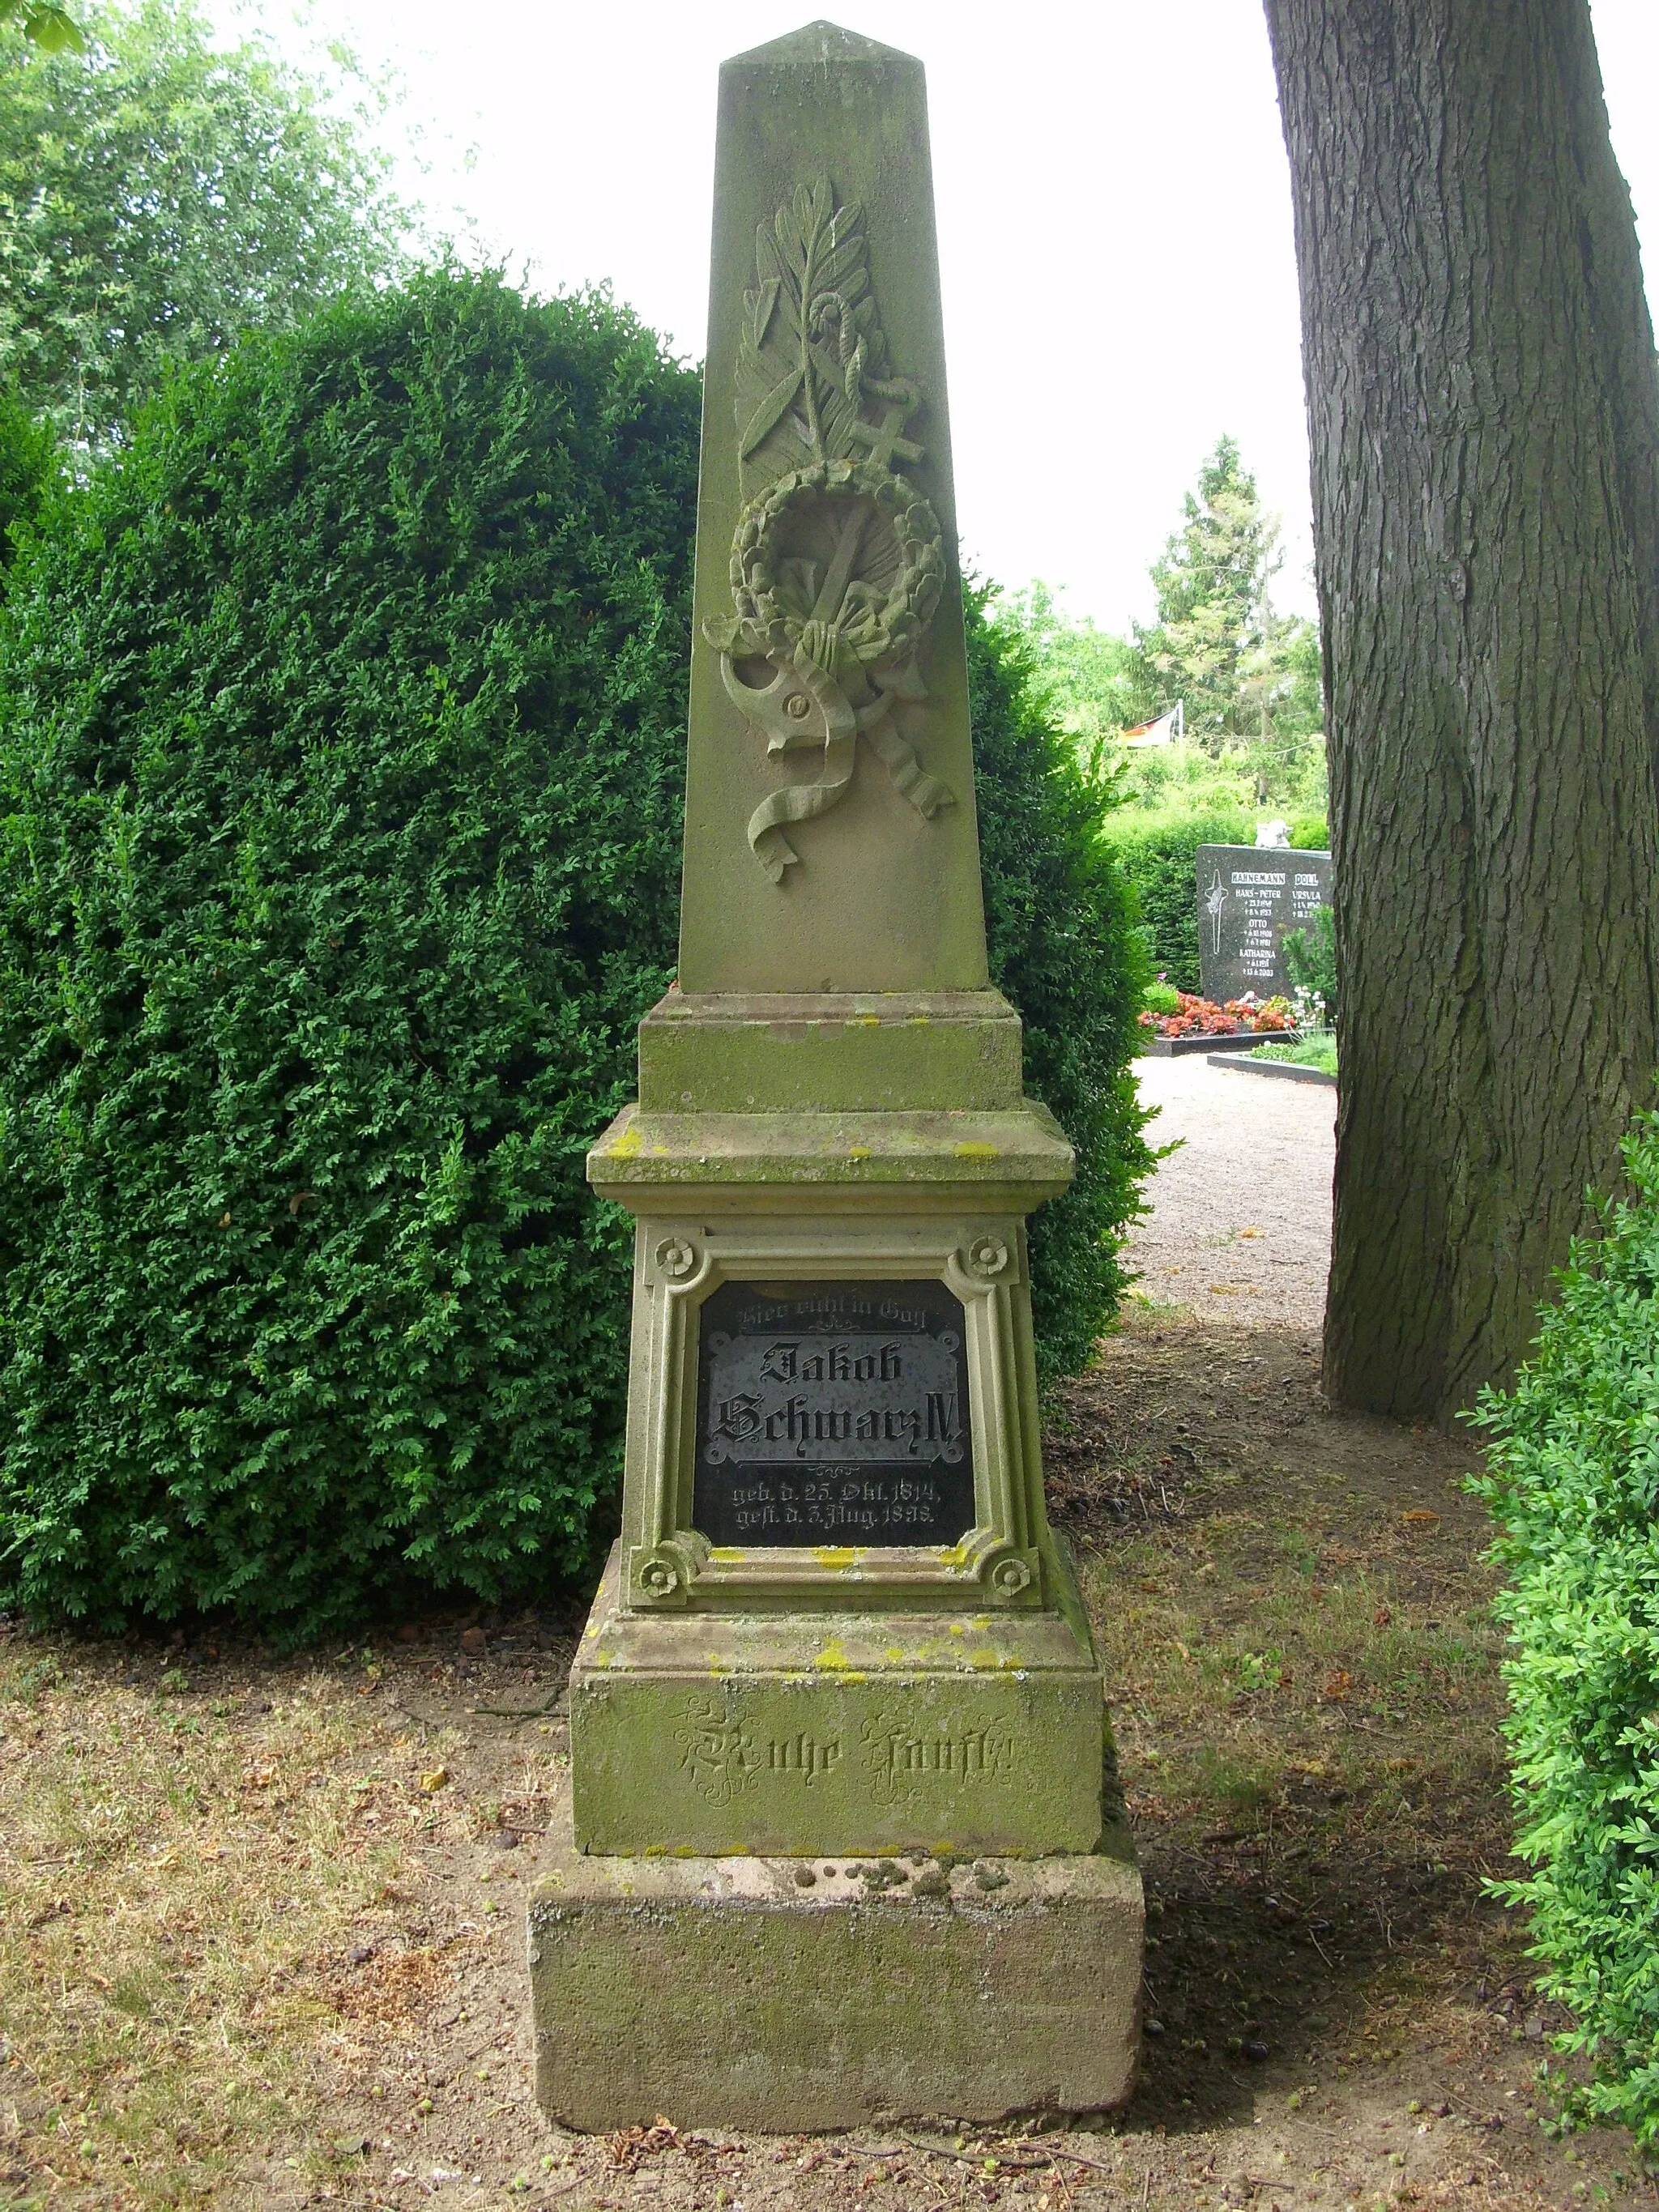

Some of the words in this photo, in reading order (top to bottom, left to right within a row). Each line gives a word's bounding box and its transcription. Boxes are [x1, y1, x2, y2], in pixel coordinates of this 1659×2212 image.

[1231, 872, 1286, 884] HAHNEMANN
[1294, 873, 1319, 886] DOLL
[1248, 919, 1267, 928] OTTO
[1239, 949, 1276, 958] KATHARINA
[760, 1339, 902, 1384] Jakob
[671, 1696, 843, 1808] Ruhe
